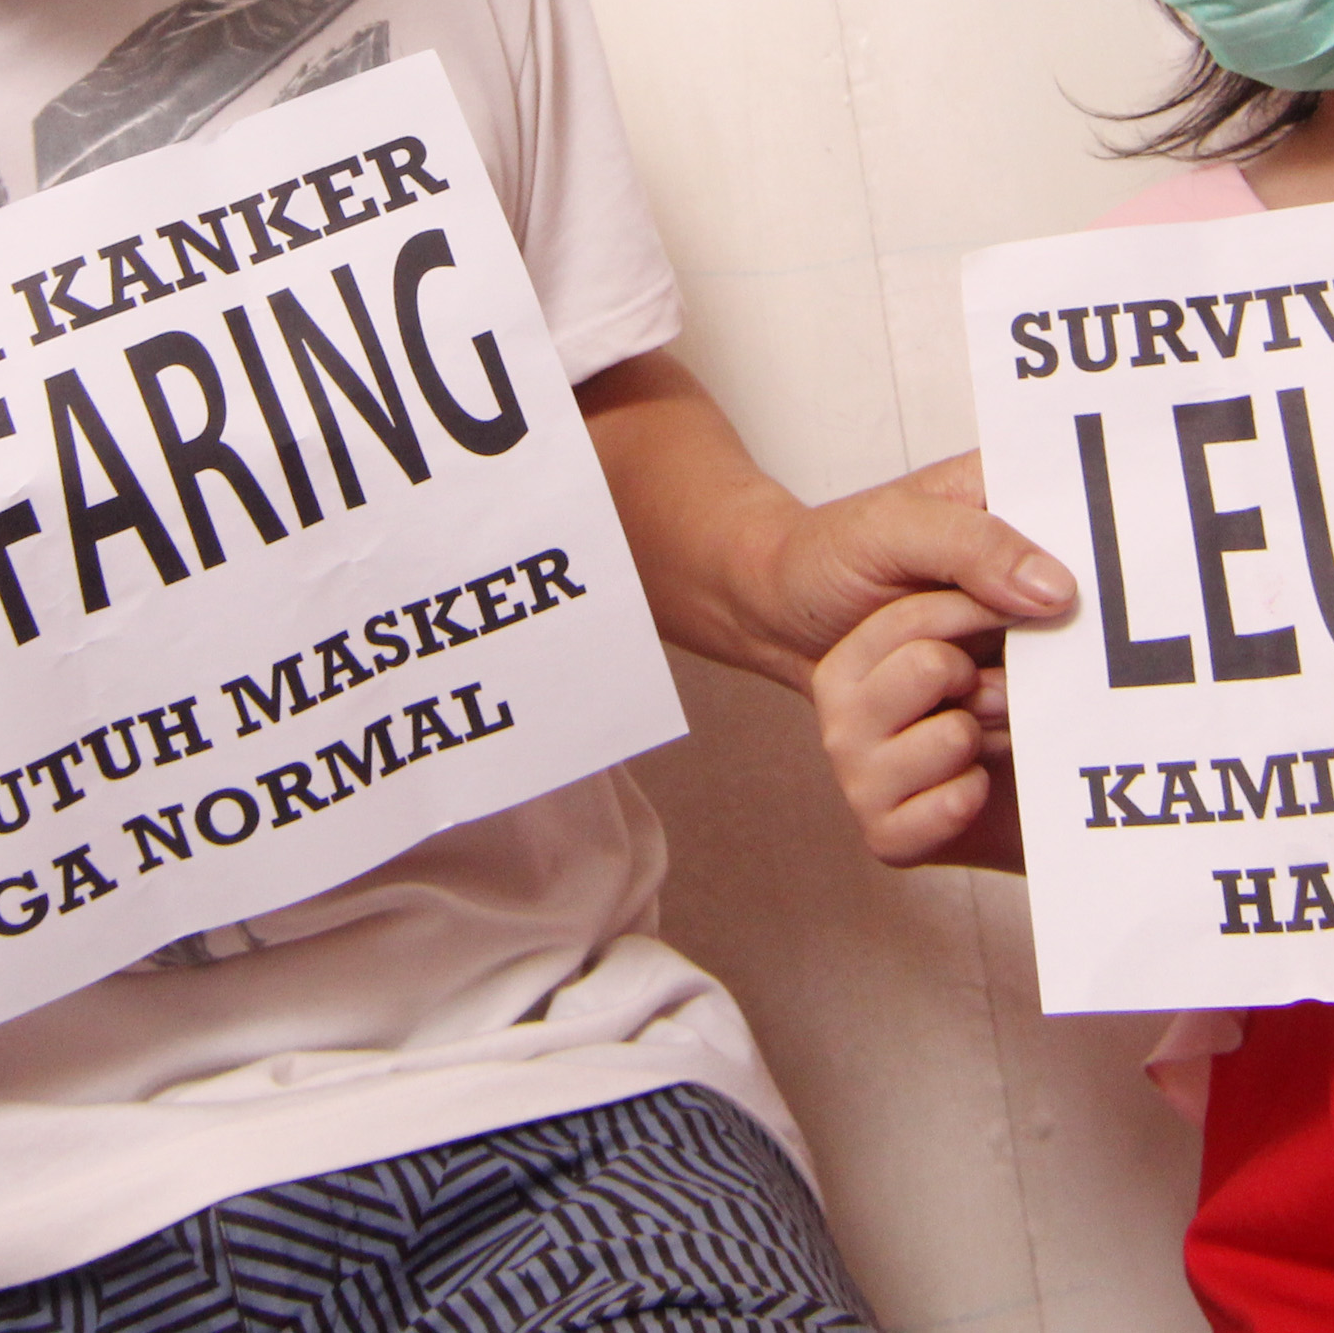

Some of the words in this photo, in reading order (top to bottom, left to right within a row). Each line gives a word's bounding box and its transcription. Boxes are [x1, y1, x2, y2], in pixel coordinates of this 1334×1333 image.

[12, 136, 450, 345] KANKER
[220, 548, 587, 738] MASKER
[121, 682, 514, 874] NORMAL
